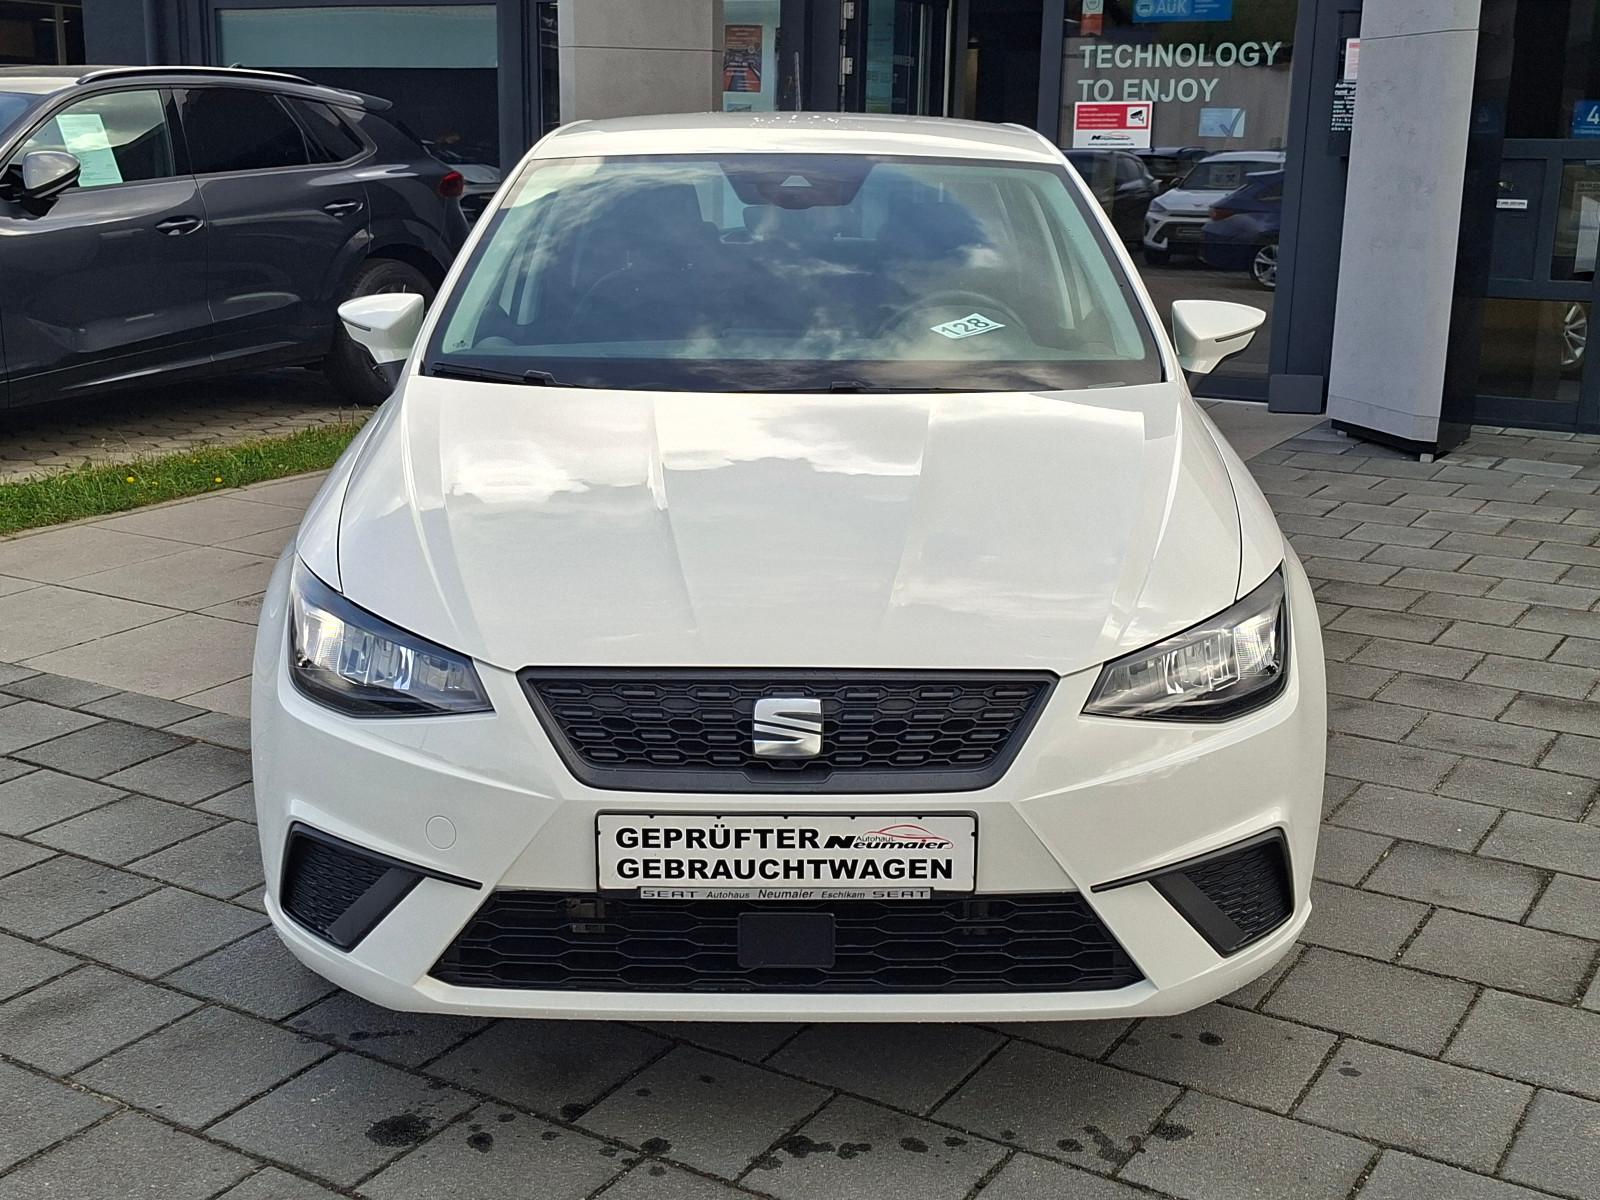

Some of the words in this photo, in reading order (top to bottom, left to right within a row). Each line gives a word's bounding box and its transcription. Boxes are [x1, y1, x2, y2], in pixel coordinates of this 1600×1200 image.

[1079, 42, 1282, 69] TECHNOLOGY
[1077, 79, 1114, 102] TO
[1122, 78, 1219, 103] ENJOY
[941, 318, 990, 336] 128
[615, 823, 820, 849] GEPRÜFTER
[823, 835, 950, 850] Neumaier
[855, 835, 895, 843] Autohaus
[616, 858, 953, 880] GEBRAUCHTWAGEN
[642, 890, 699, 898] SEAT
[706, 890, 751, 899] Autohaus
[757, 889, 815, 899] Neumaier
[872, 890, 930, 898] SEAT
